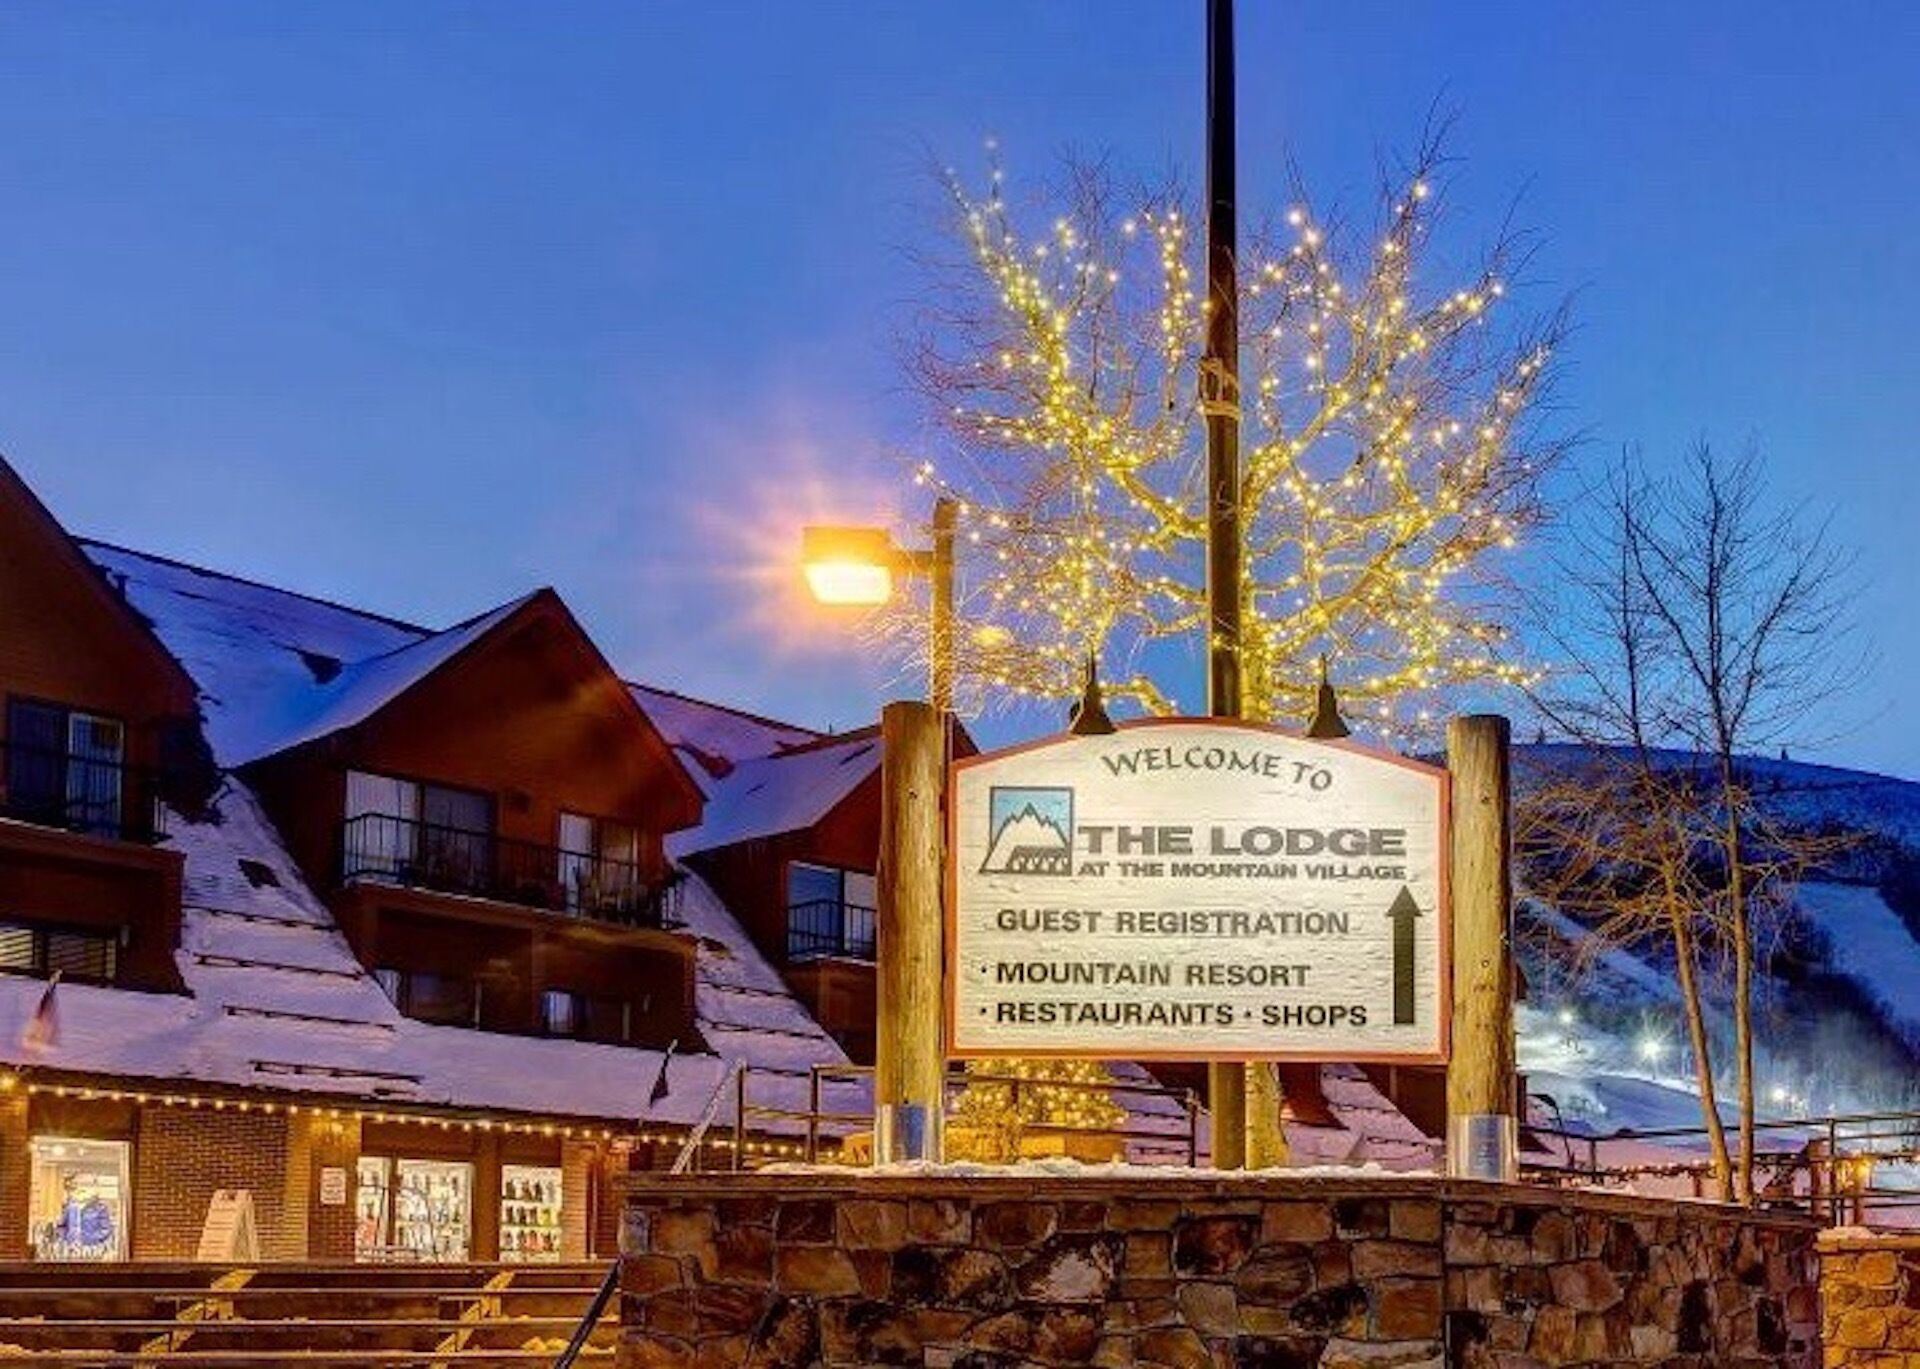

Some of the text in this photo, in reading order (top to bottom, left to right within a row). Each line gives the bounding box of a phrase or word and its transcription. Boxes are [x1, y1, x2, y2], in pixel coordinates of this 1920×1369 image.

[1102, 746, 1333, 792] WELCOME TO
[1078, 826, 1407, 856] THE LODGE
[1077, 861, 1406, 880] AT THE MOUNTAIN VILLAGE
[997, 909, 1350, 935] GUEST REGISTRATION
[996, 962, 1311, 986] MOUNTAIN RESORT
[997, 1002, 1368, 1026] RESTAURANTS SHOPS
